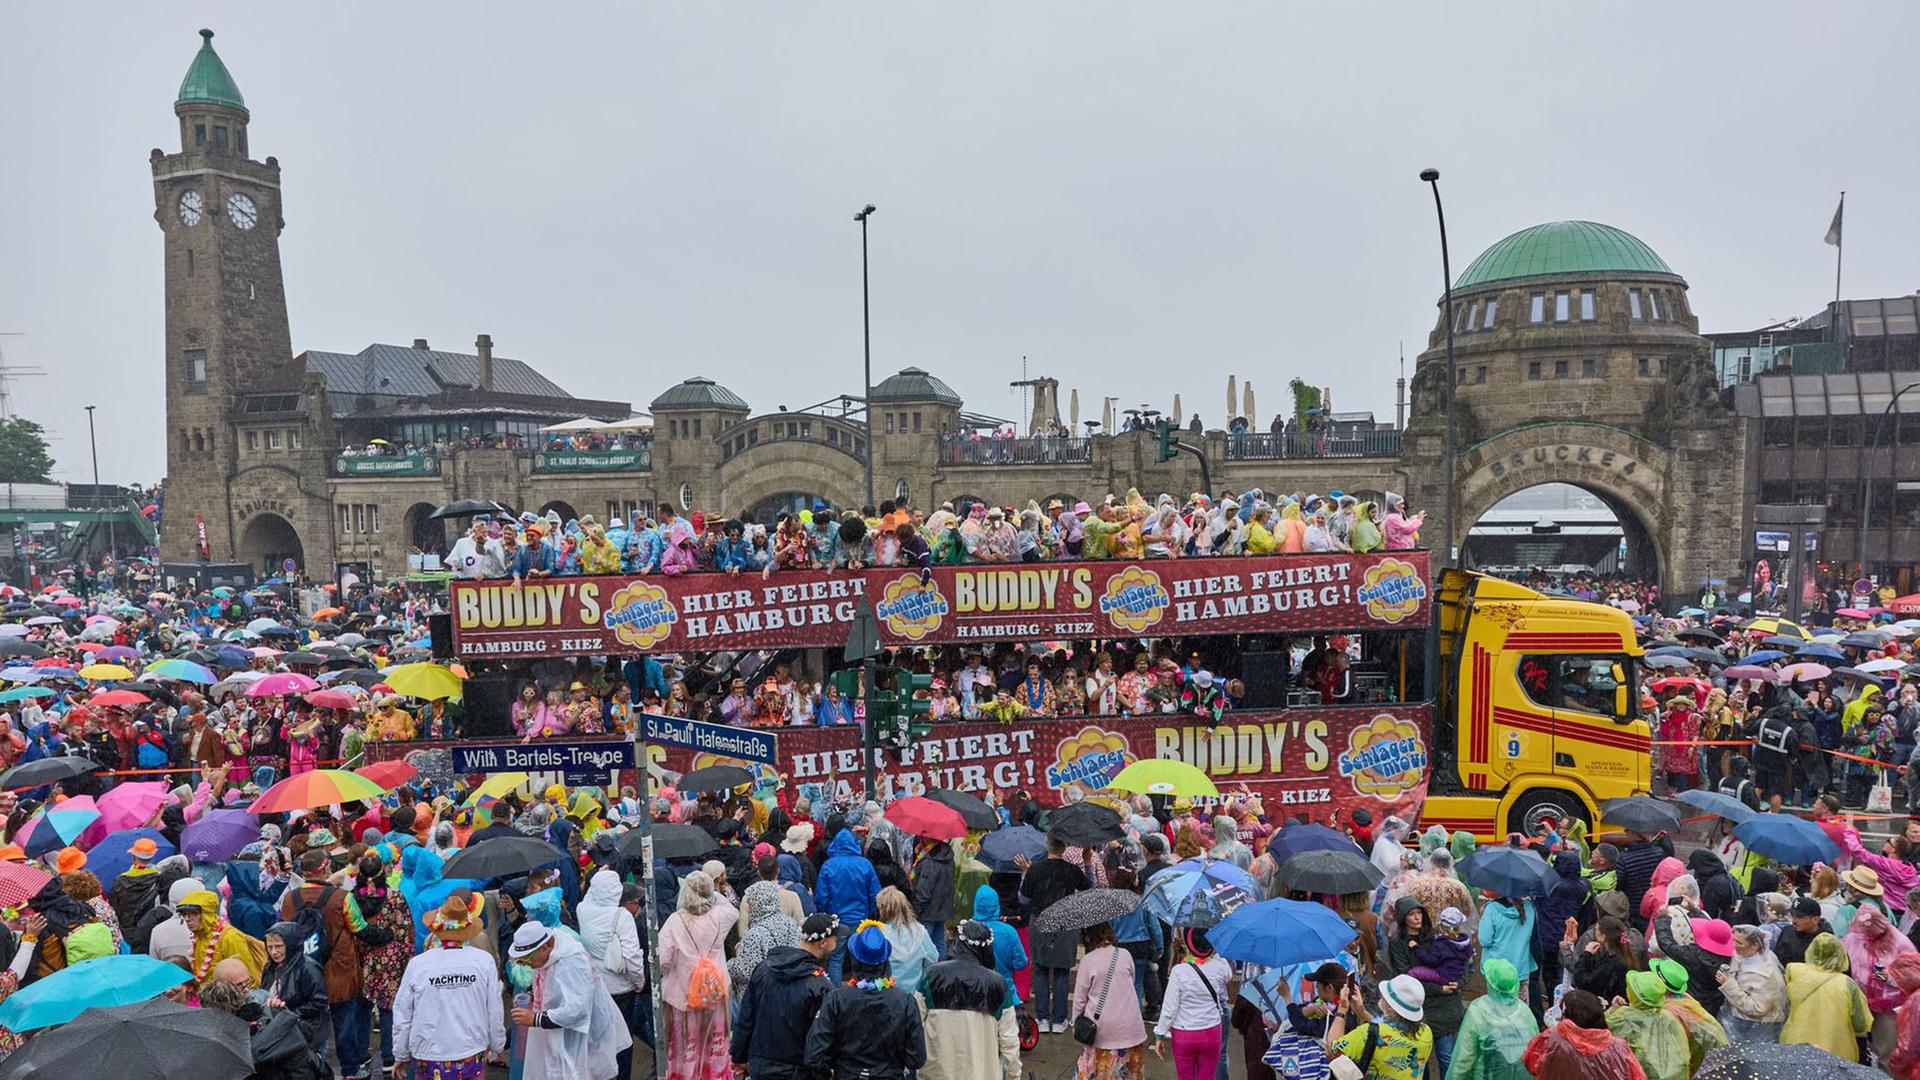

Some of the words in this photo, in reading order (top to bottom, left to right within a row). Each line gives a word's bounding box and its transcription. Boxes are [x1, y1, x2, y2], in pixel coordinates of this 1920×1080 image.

[682, 590, 749, 613] HIER
[763, 578, 867, 603] FEIERT
[955, 568, 1092, 612] BUDDY'S
[1173, 575, 1242, 598] HIER
[1251, 563, 1351, 590] FEIERT
[1359, 576, 1414, 603] Schlager
[457, 583, 600, 628] BUDDY'S
[606, 599, 664, 627] Schlager
[879, 591, 935, 619] Schlager
[1101, 584, 1156, 611] Schlager
[1175, 585, 1351, 622] HAMBURG!
[462, 640, 547, 654] HAMBURG
[562, 638, 602, 650] KIEZ
[957, 624, 1039, 637] HAMBURG
[1055, 622, 1094, 635] KIEZ
[695, 727, 768, 758] Hafenstraße
[900, 730, 1035, 767] FEIERT
[1155, 720, 1329, 776] BUDDY'S
[1340, 737, 1416, 775] Schlager
[1507, 740, 1521, 758] 9
[796, 759, 1036, 802] ABURG!
[1048, 749, 1125, 788] Schlager
[1281, 788, 1331, 804] KIEZ
[428, 974, 477, 985] YACHTING
